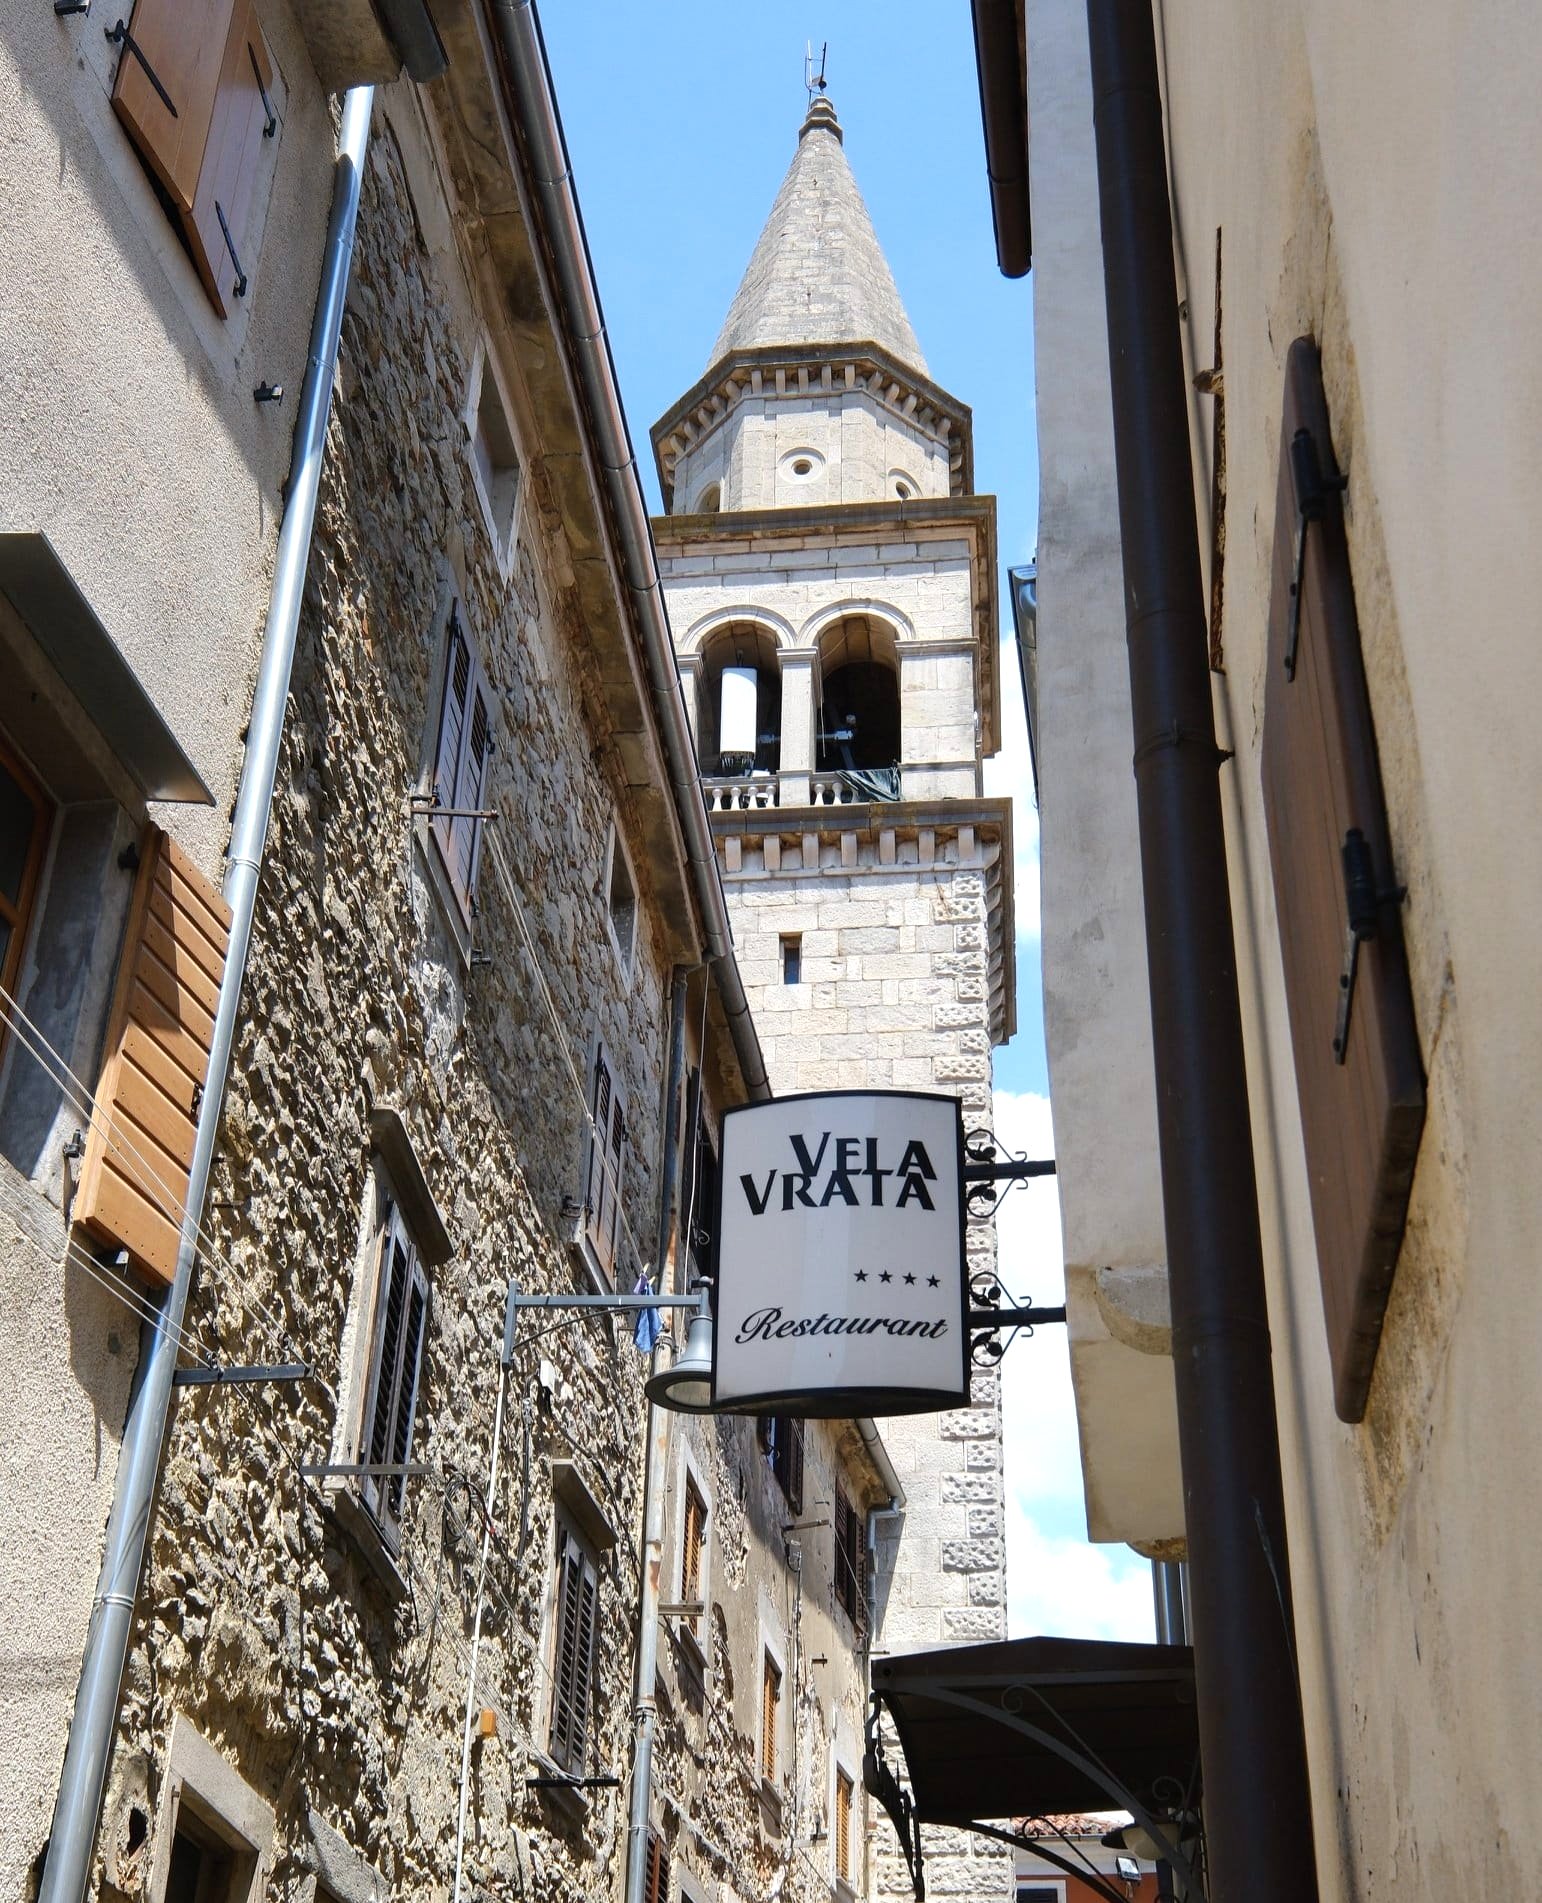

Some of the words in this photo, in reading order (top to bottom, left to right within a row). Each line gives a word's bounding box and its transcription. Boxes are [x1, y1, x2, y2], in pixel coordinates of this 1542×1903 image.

[789, 1132, 937, 1181] VELA
[739, 1169, 936, 1216] VRATA
[735, 1307, 949, 1344] Restaurant
